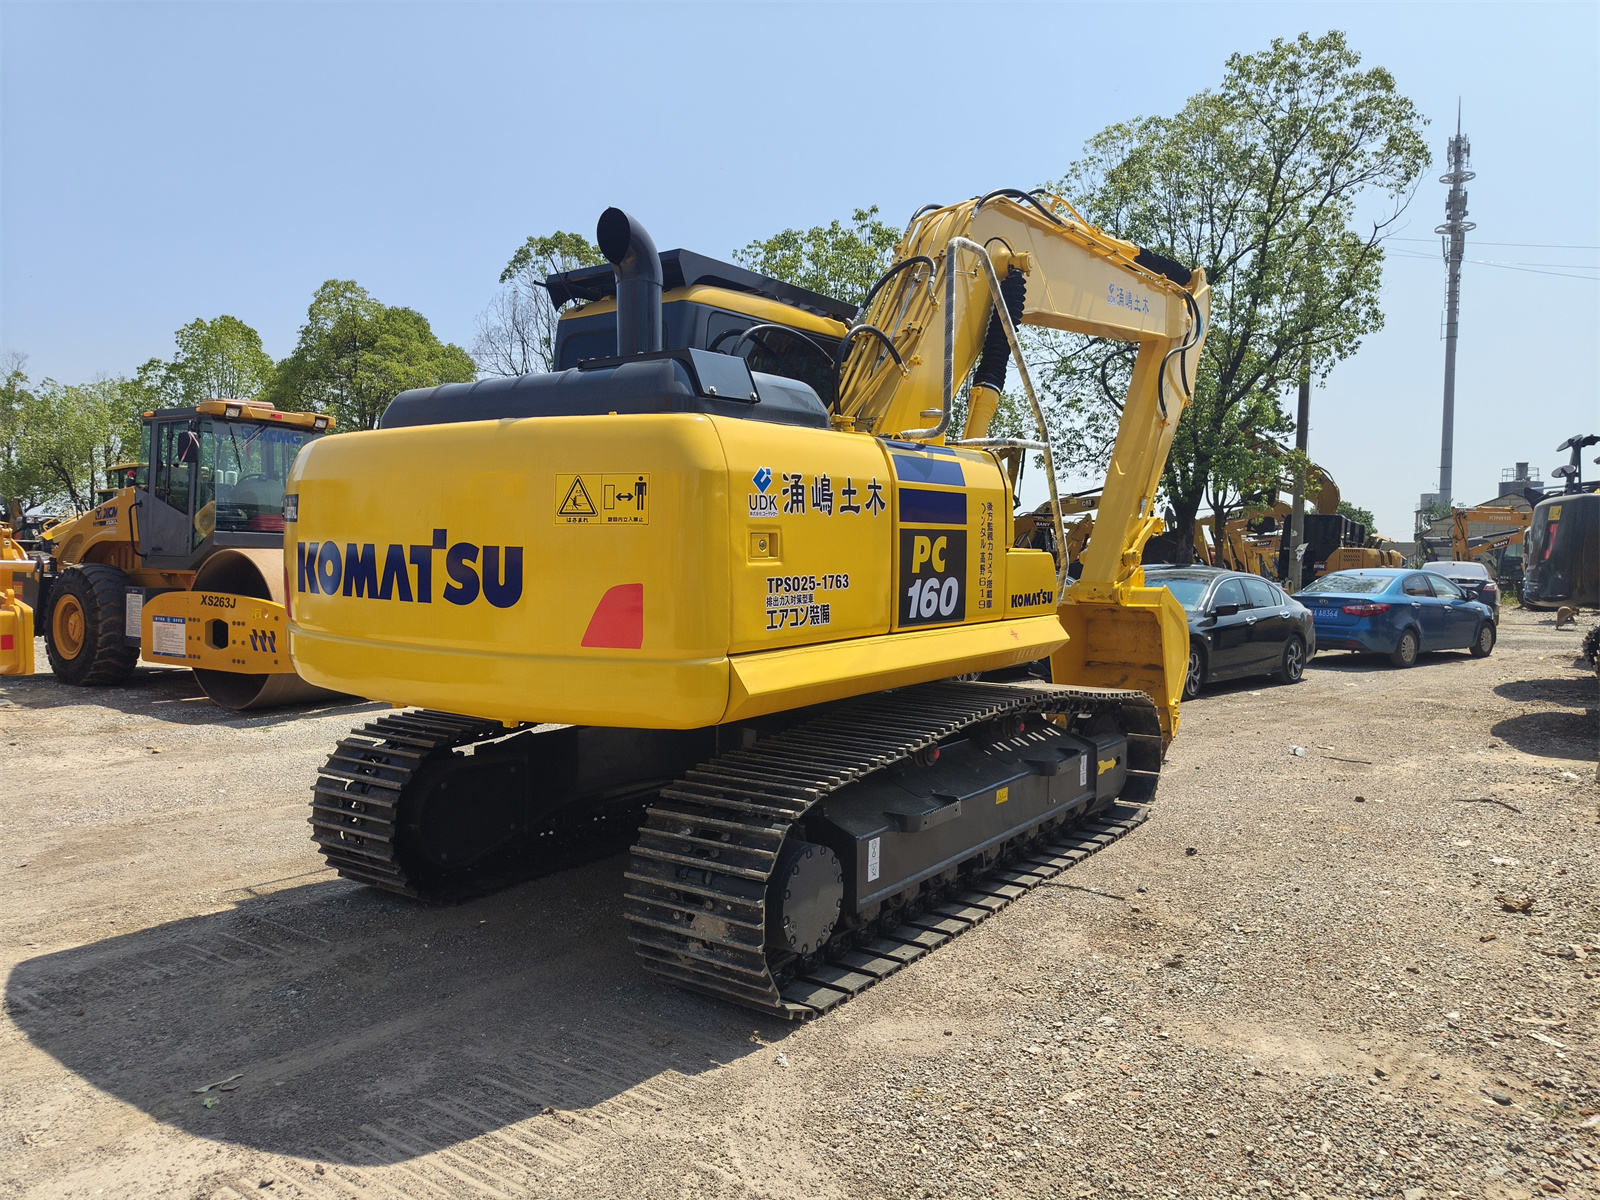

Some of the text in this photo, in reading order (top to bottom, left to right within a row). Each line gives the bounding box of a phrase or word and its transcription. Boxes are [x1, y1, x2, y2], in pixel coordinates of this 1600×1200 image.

[749, 495, 777, 510] UDK
[782, 473, 886, 516] 涌嶋土木
[298, 529, 523, 608] KOMATSU
[912, 535, 947, 573] PC
[201, 595, 236, 608] XS263J
[908, 576, 959, 619] 160
[1011, 589, 1053, 608] KOMATSU
[766, 604, 830, 630] エアコン装備
